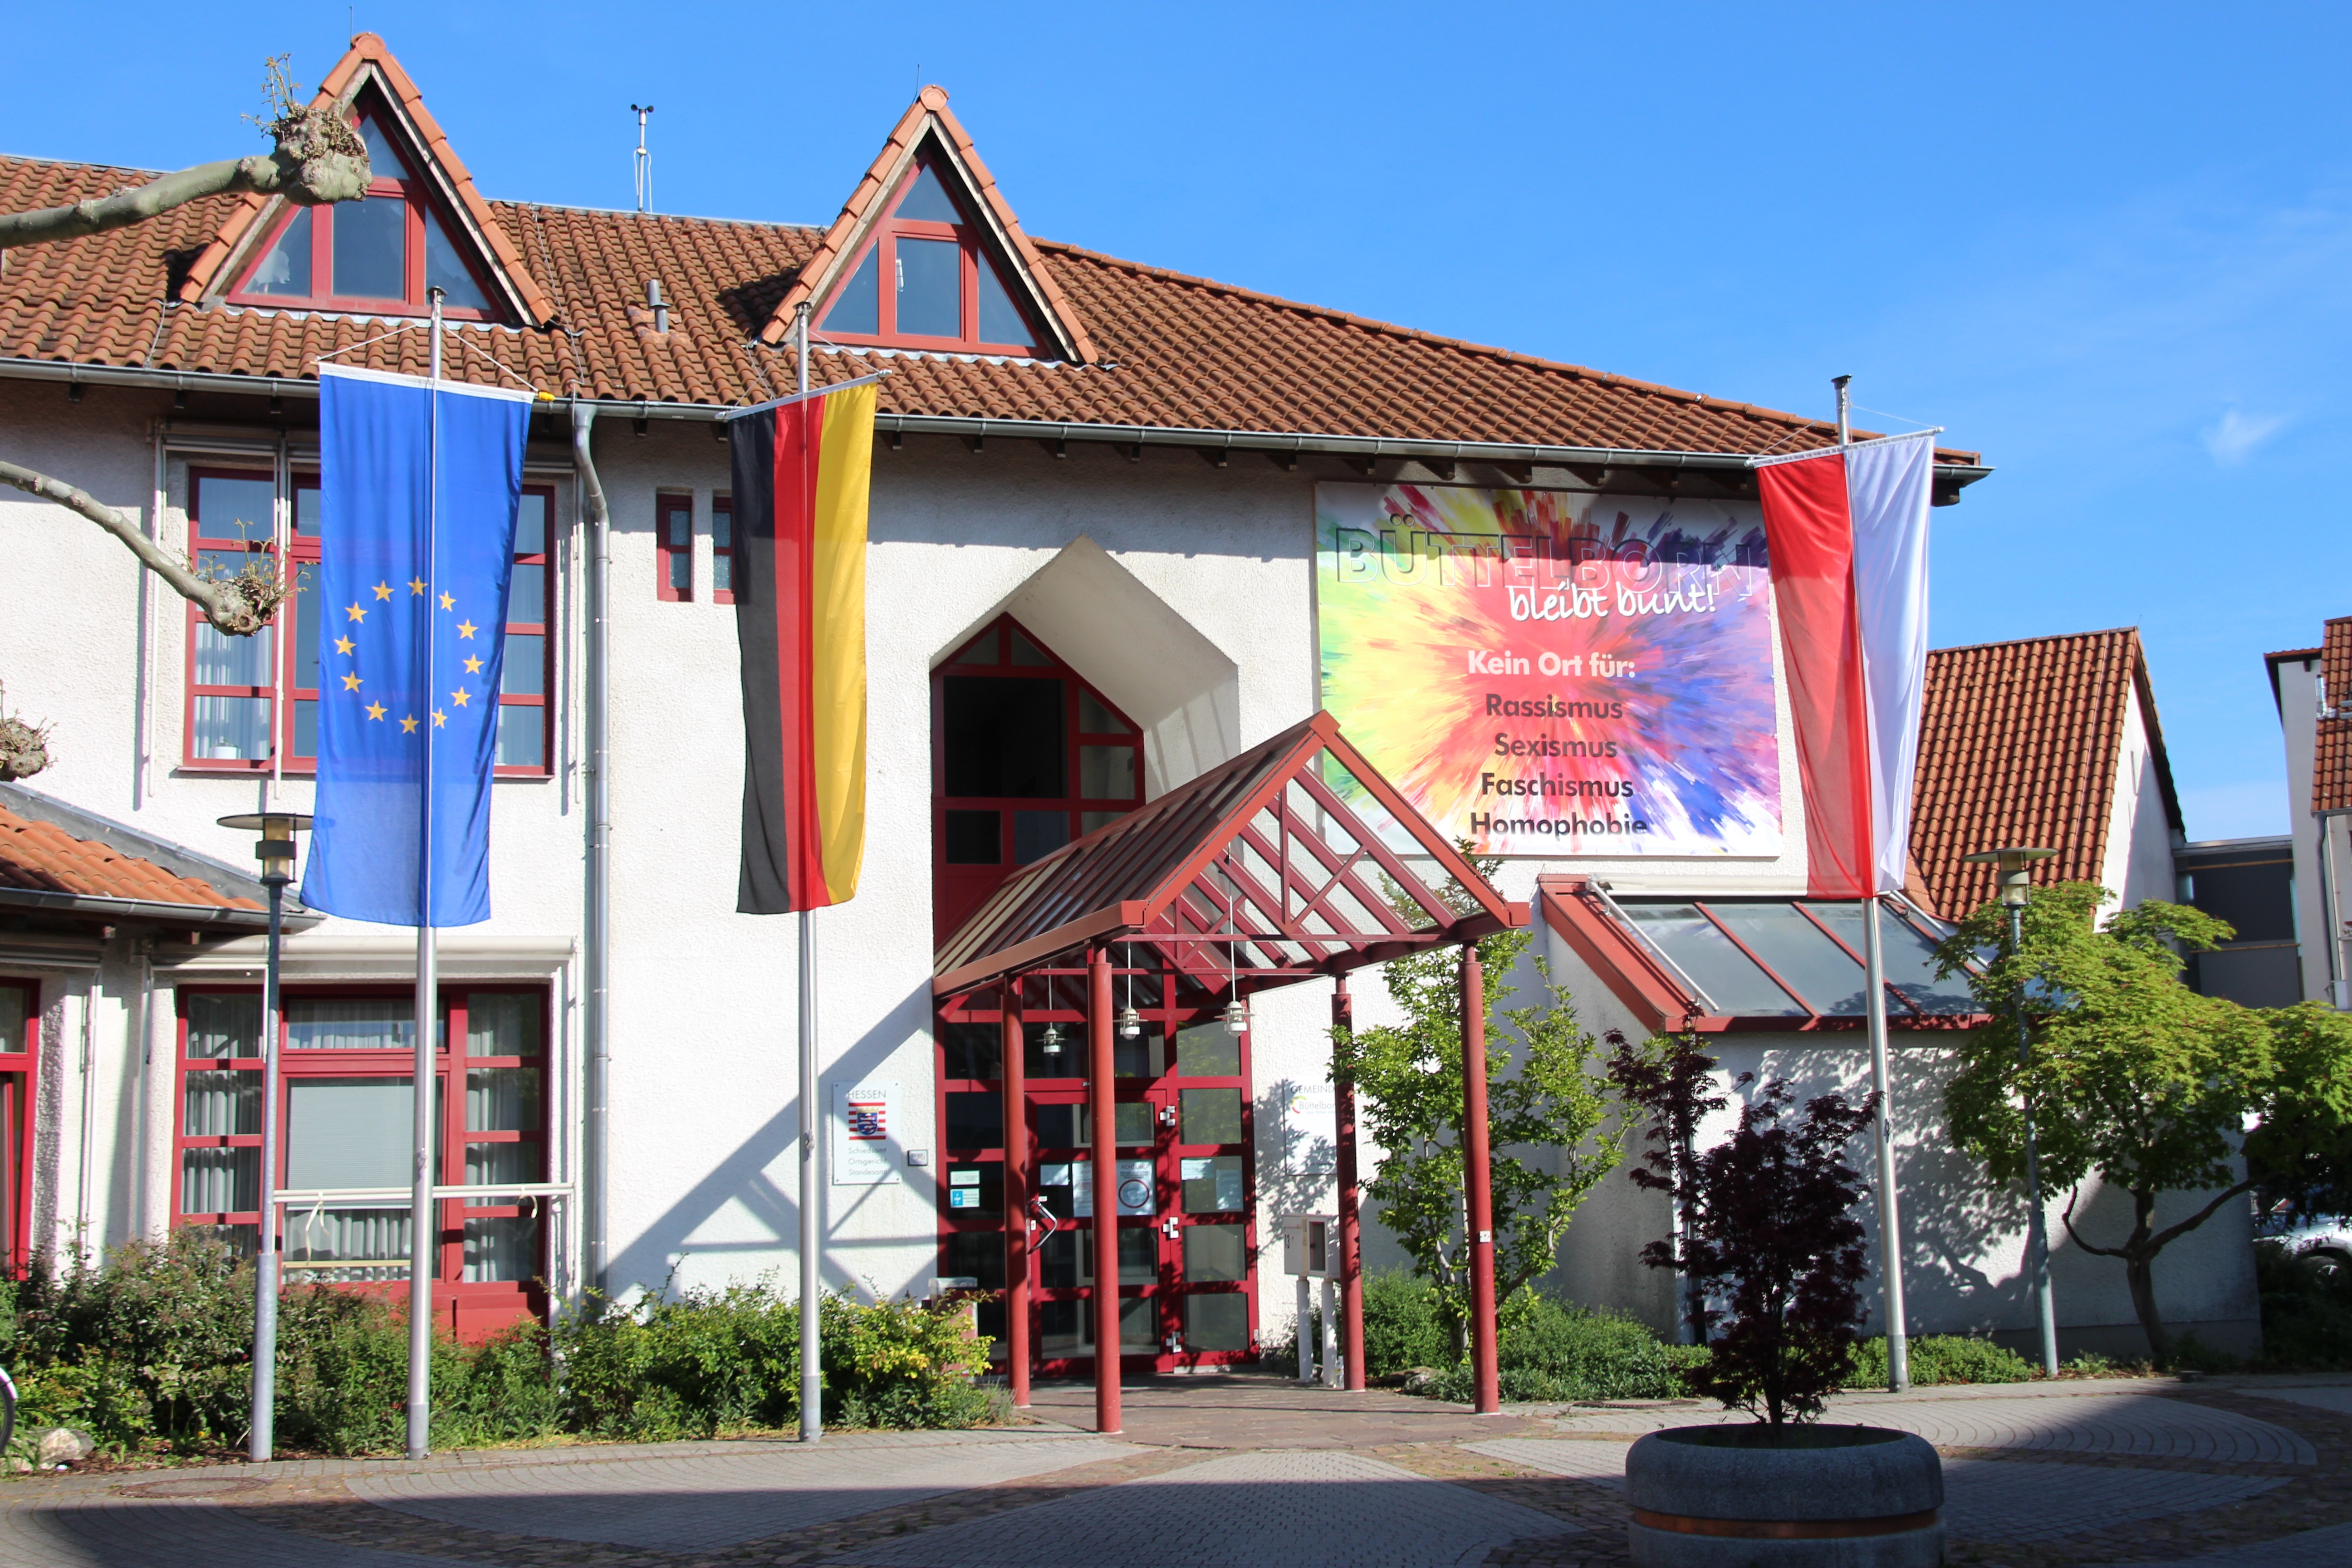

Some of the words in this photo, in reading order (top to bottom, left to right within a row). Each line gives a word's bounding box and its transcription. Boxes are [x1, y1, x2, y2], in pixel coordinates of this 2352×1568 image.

[1335, 513, 1752, 596] BÜTTELBORN
[1508, 581, 1608, 622] bleibt
[1615, 580, 1716, 617] bunt!
[1467, 650, 1530, 675] Kein
[1538, 652, 1583, 676] Ort
[1588, 652, 1636, 678] für:
[1485, 693, 1623, 719] Rassismus
[1494, 733, 1617, 758] Sexismus
[1481, 772, 1634, 798] Faschismus
[1470, 812, 1647, 842] Homophobie
[847, 1090, 887, 1099] HESSEN
[1291, 1085, 1334, 1093] GEMEIND
[1299, 1100, 1335, 1110] Büttelbor
[848, 1157, 887, 1166] Ortsgericht
